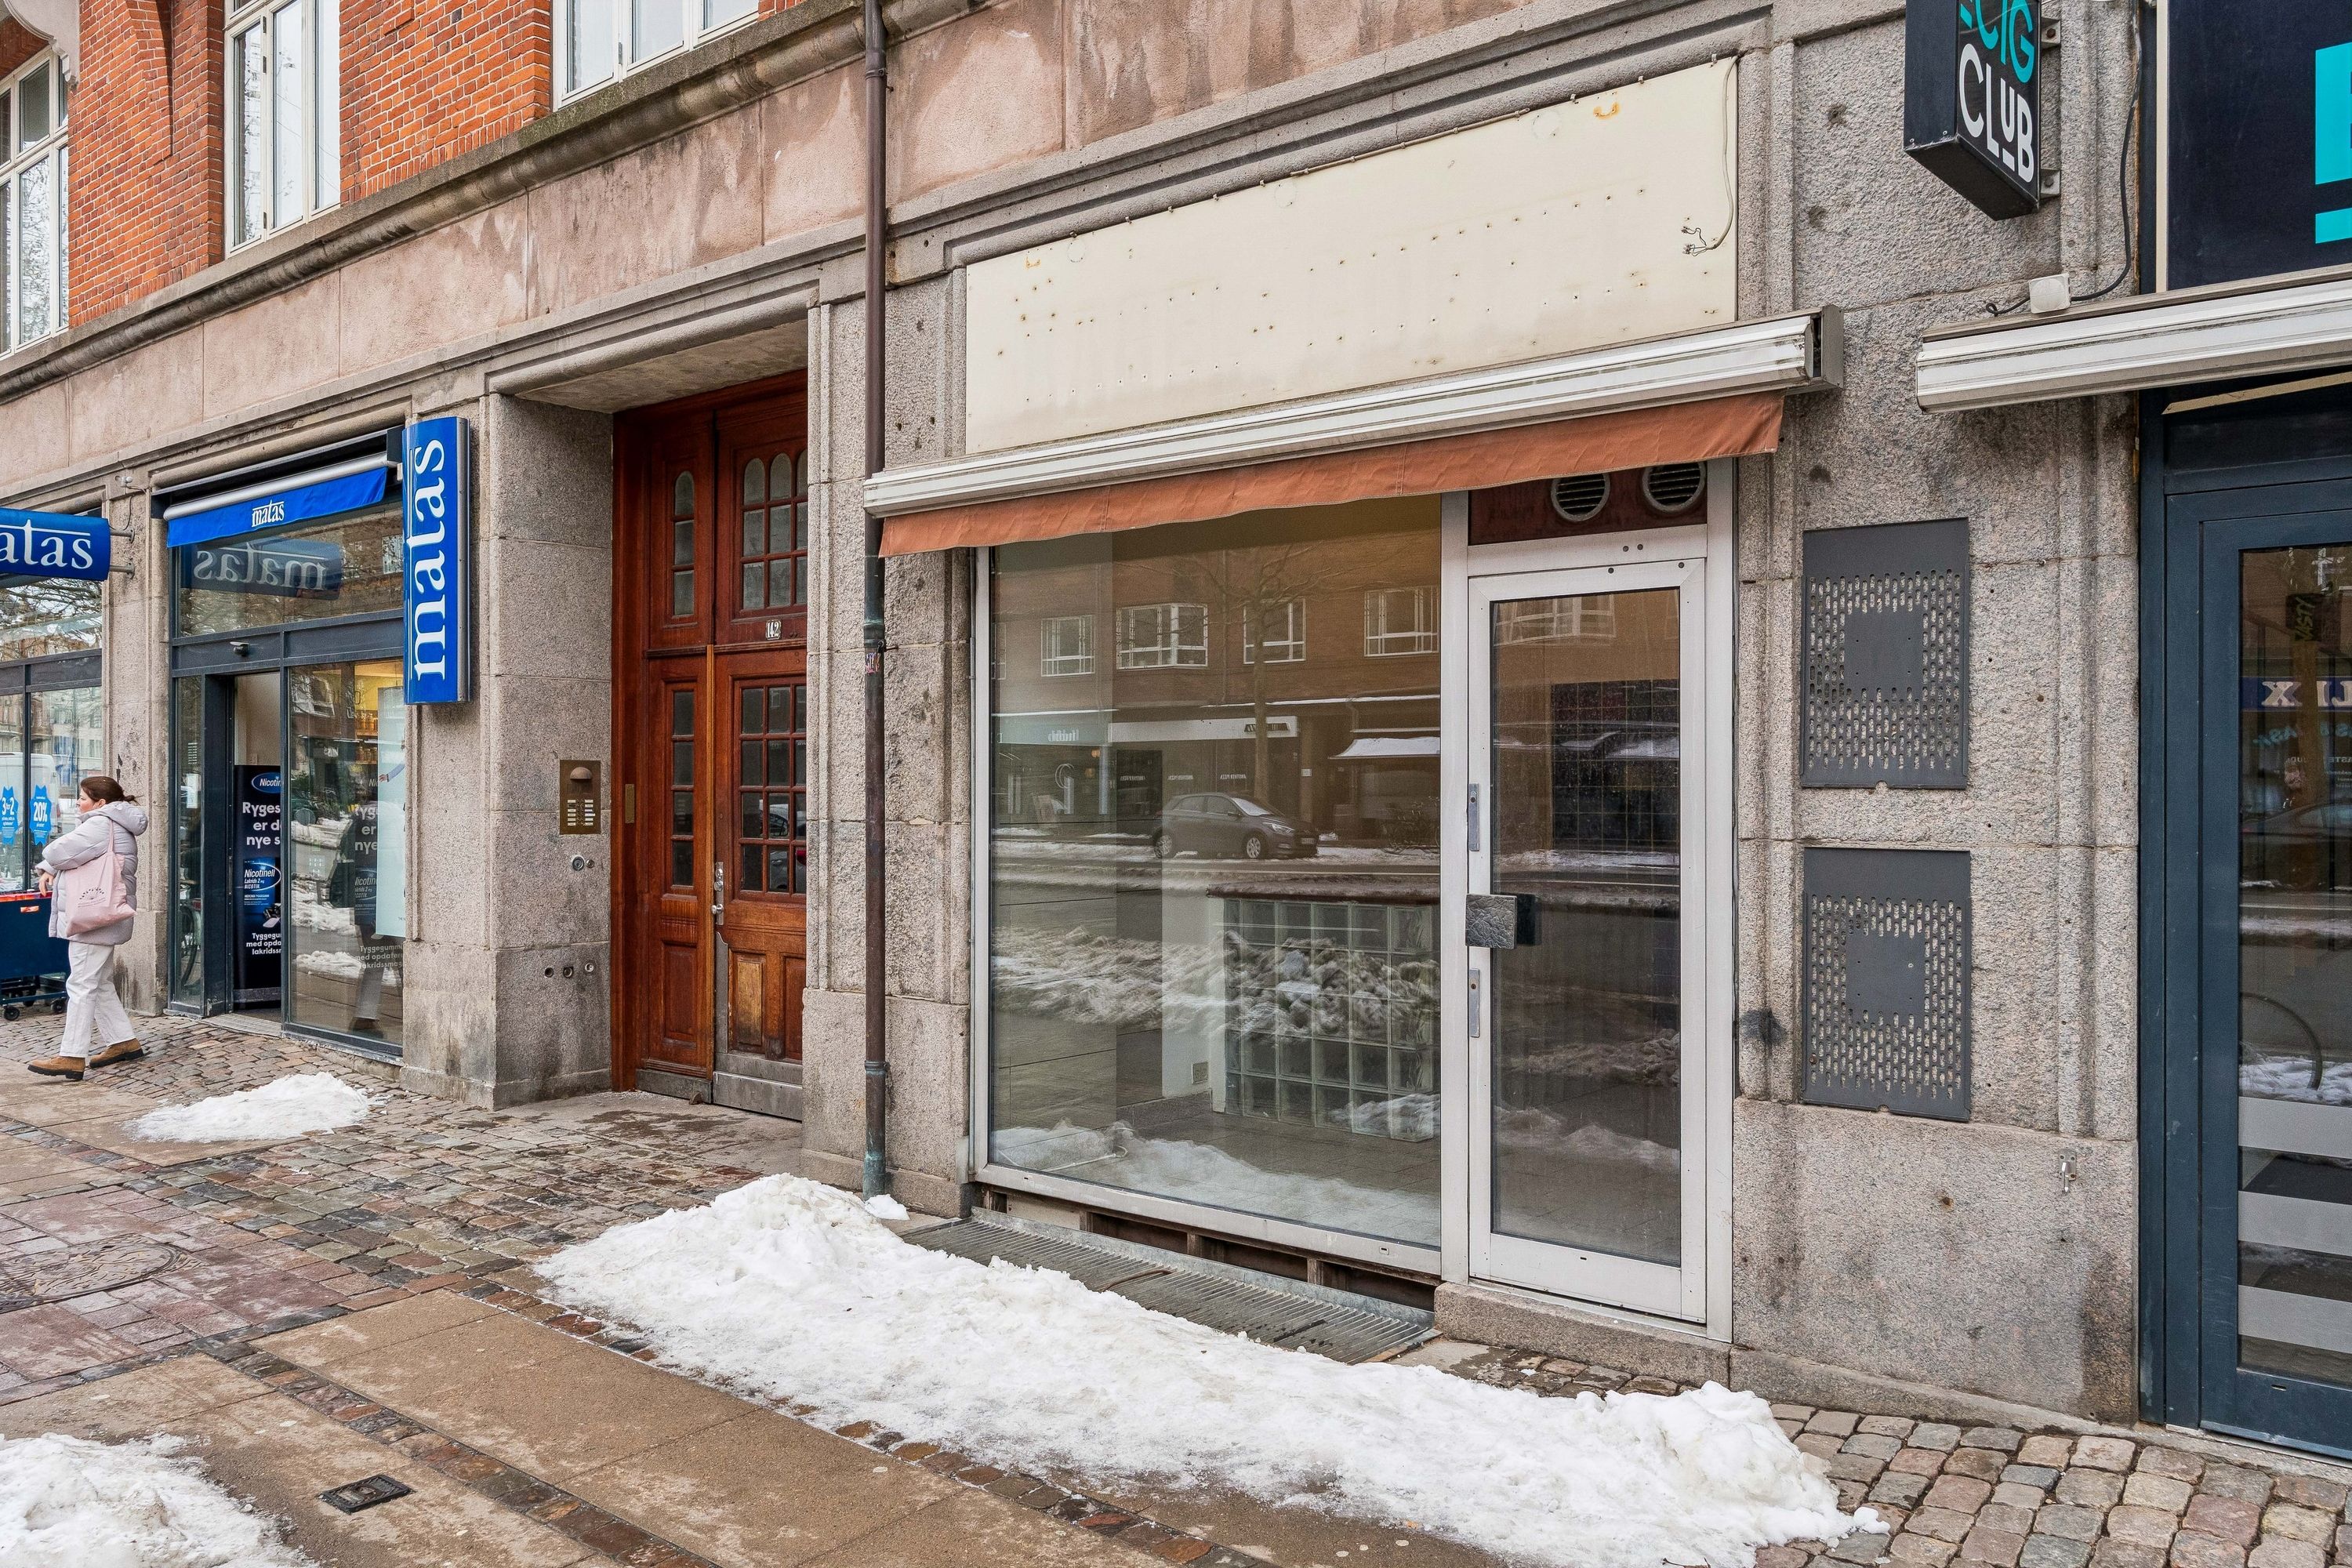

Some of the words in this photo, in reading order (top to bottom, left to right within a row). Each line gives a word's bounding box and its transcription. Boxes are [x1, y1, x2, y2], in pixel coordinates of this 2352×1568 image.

[1960, 0, 2035, 83] CIG
[1959, 43, 2035, 183] CLUB
[252, 499, 285, 528] matas
[406, 439, 446, 681] matas
[766, 621, 780, 638] 142
[2, 797, 6, 815] 3
[10, 797, 15, 815] 2
[33, 801, 48, 822] 20%
[242, 801, 281, 818] Ryges
[253, 822, 268, 831] er
[270, 819, 282, 831] d
[361, 826, 376, 835] er
[246, 837, 271, 849] nye
[354, 841, 378, 855] nye
[244, 869, 276, 878] Nicotinell
[252, 932, 281, 941] Tyggegu
